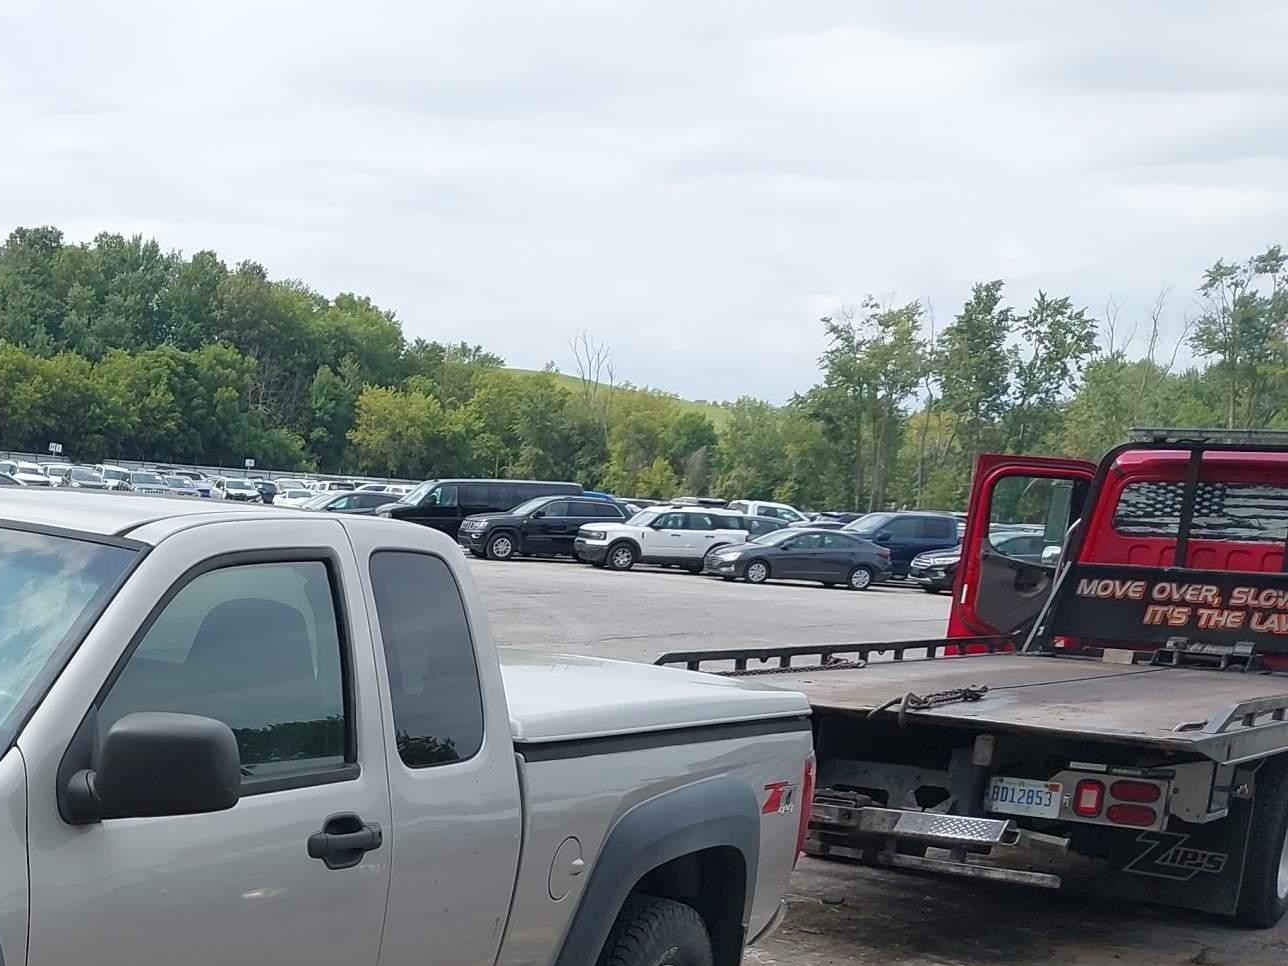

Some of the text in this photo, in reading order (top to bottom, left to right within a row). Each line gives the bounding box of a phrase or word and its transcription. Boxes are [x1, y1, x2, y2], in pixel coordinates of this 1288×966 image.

[1076, 578, 1146, 600] MOVE
[1151, 582, 1222, 607] OVER,
[1142, 604, 1192, 627] IT'S
[1196, 608, 1246, 630] THE
